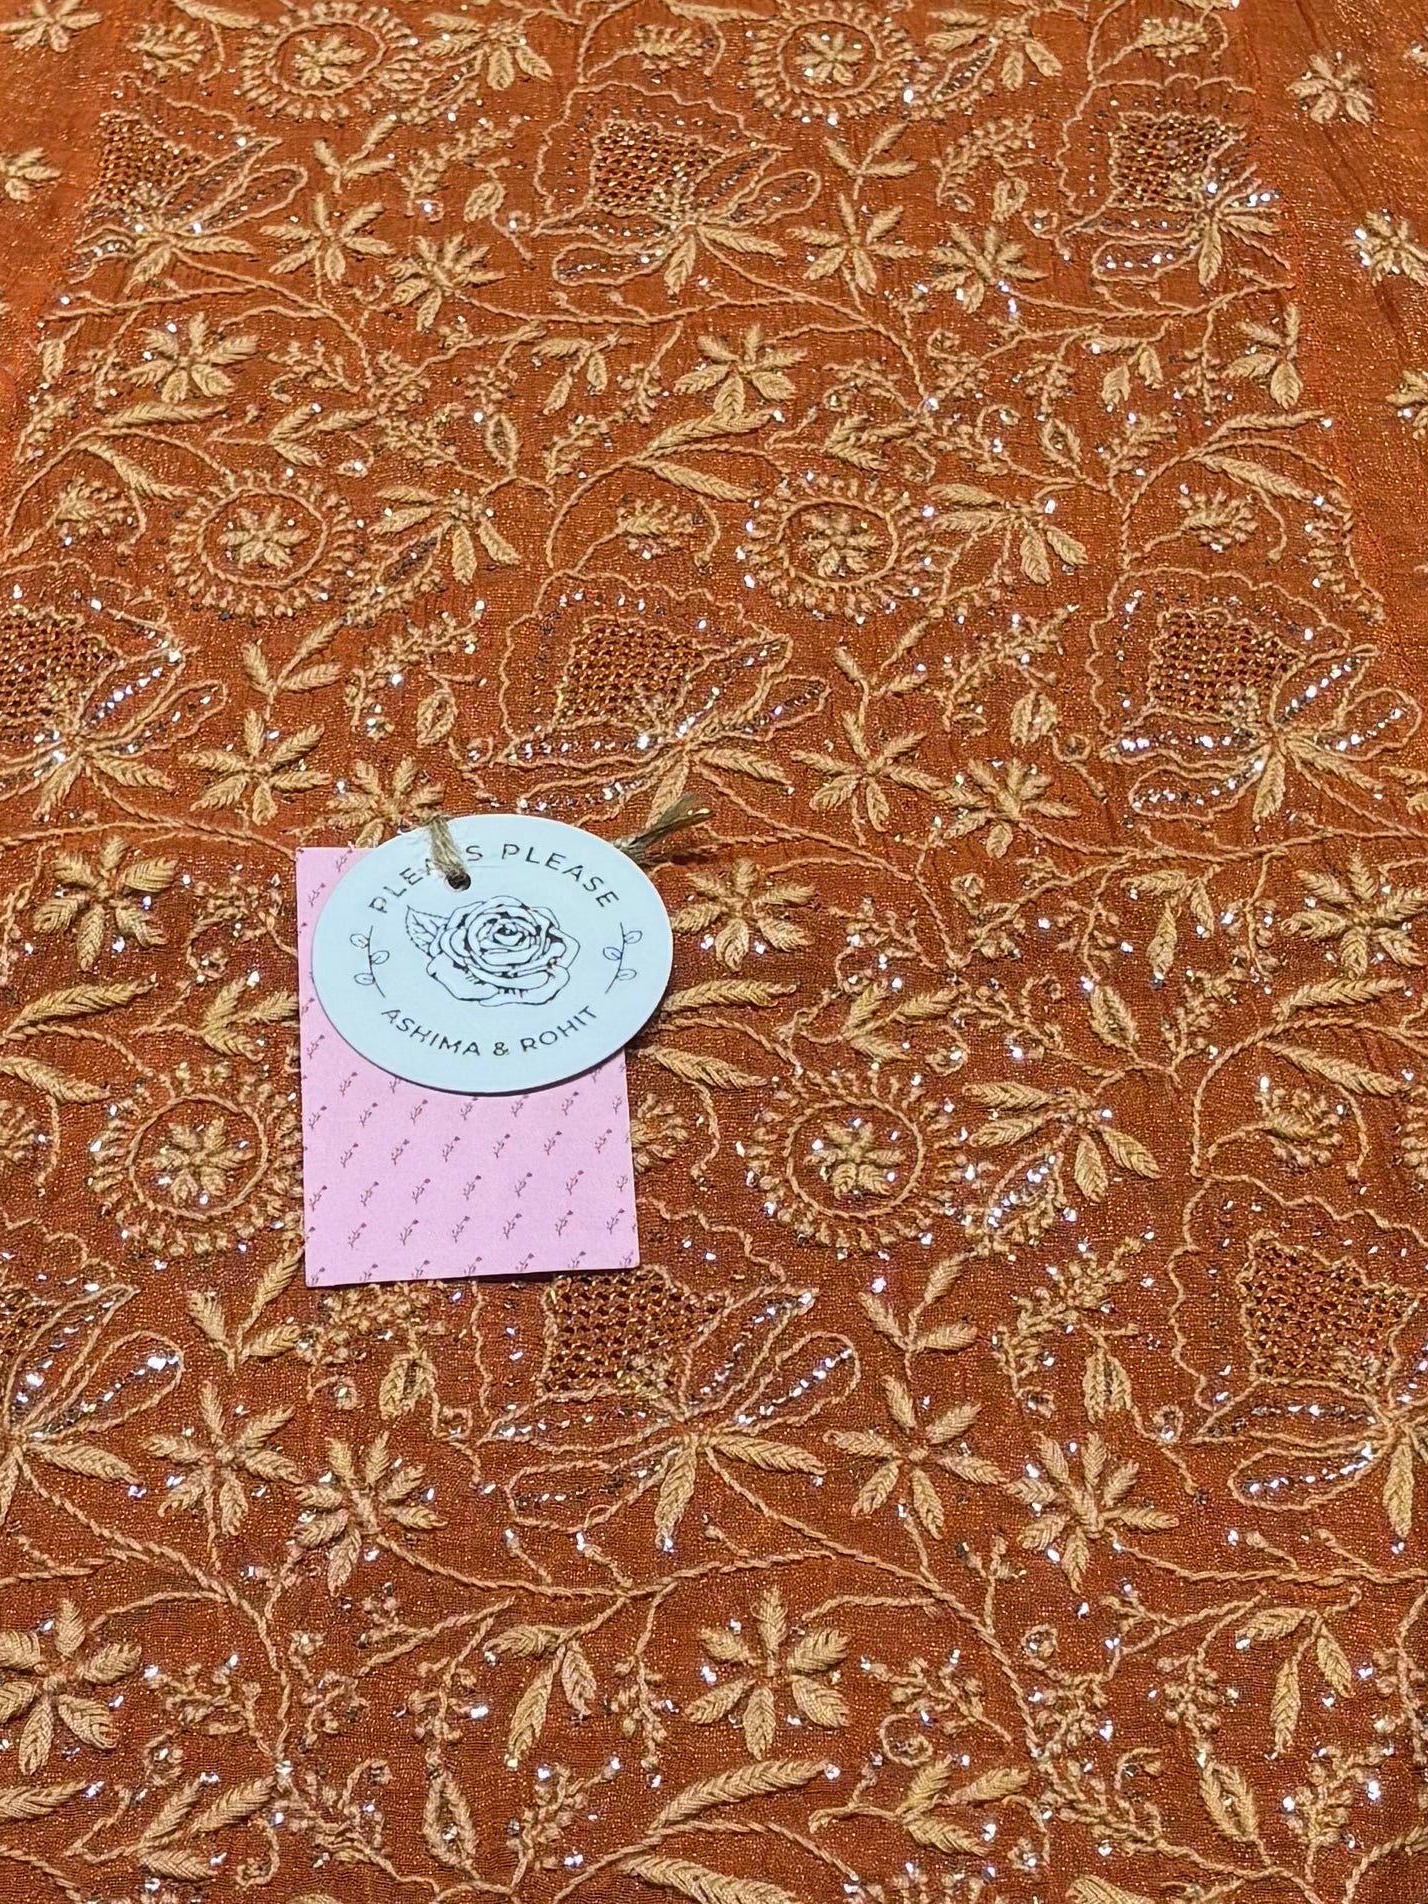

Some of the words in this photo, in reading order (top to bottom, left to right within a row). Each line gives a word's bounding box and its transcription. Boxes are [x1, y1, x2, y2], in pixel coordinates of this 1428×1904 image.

[368, 844, 484, 914] PLEAS
[501, 843, 620, 908] PLEASE
[381, 1008, 481, 1057] ASHIMA
[492, 1040, 510, 1057] &
[519, 1004, 598, 1053] ROHIT
